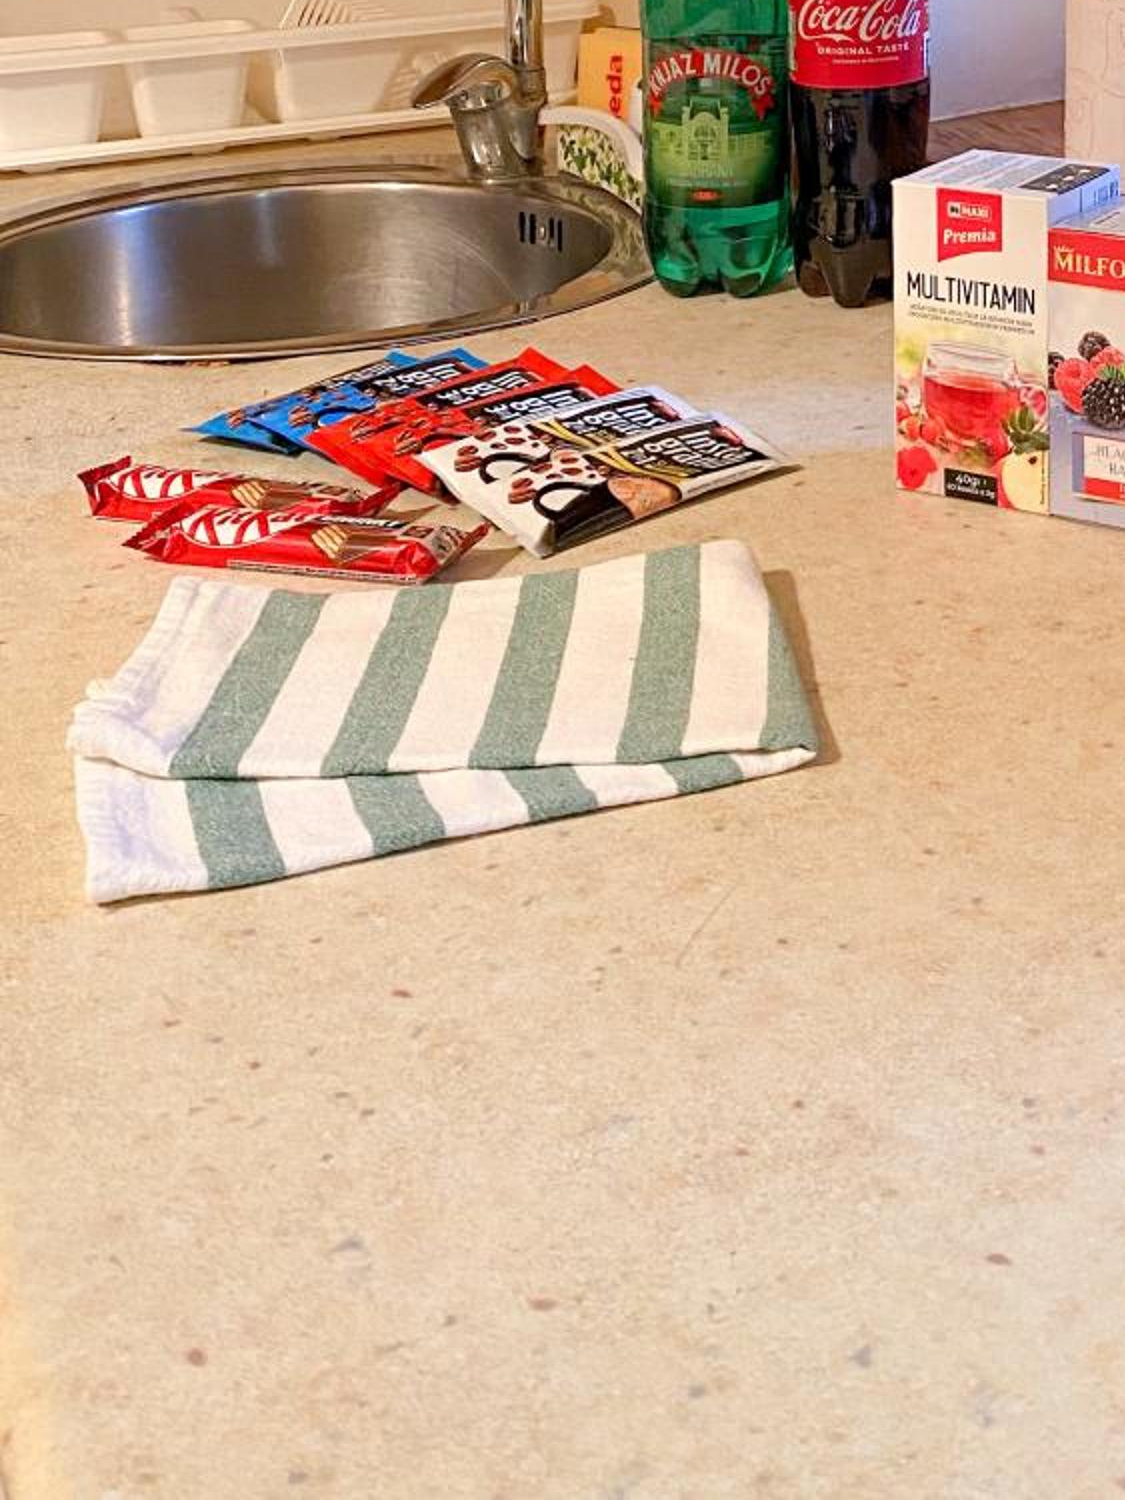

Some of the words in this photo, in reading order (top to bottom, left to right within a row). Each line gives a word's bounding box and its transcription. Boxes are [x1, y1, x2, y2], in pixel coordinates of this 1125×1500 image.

[817, 45, 873, 55] ORIGINAL
[876, 41, 909, 53] TASTE
[606, 54, 624, 120] eda
[649, 52, 697, 97] KNJAZ
[943, 228, 997, 245] Premia
[906, 271, 1036, 316] MULTIVITAMIN
